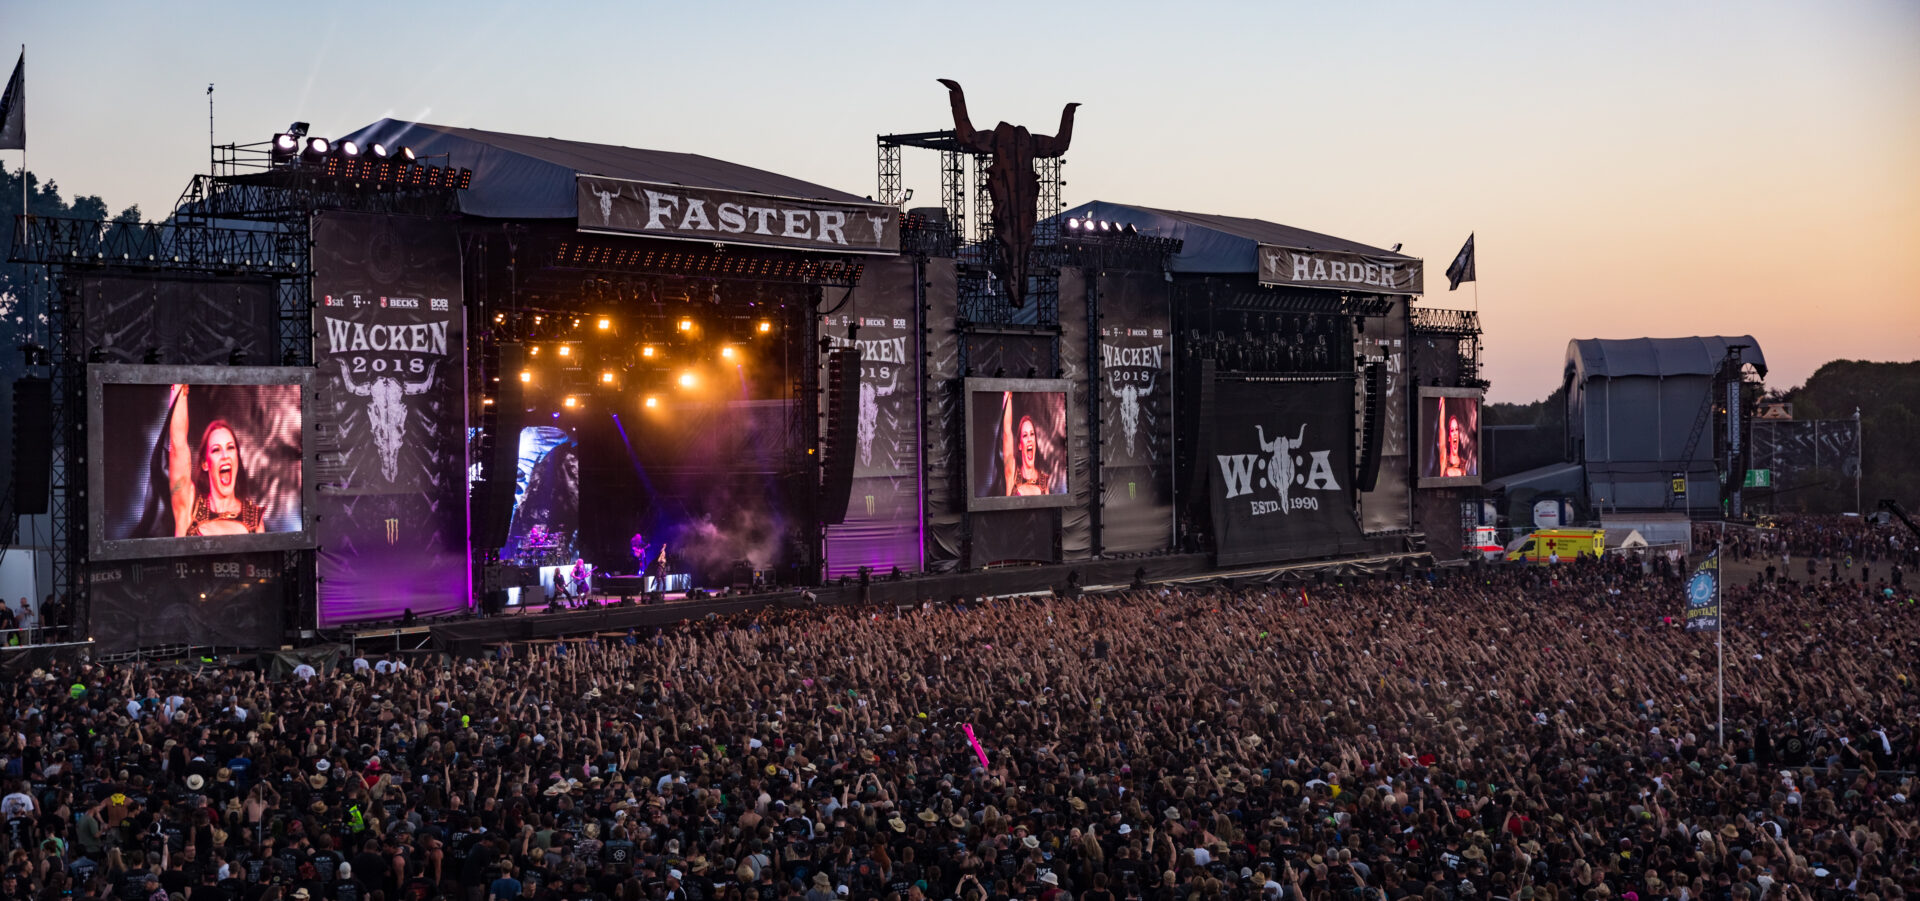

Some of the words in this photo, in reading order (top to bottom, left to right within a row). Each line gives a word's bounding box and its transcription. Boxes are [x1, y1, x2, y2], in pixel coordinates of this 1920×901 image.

[643, 188, 849, 246] FASTER
[1291, 253, 1397, 289] HARDER
[325, 295, 344, 307] 3sat
[390, 299, 419, 307] BECK'S
[325, 316, 449, 356] WACKEN
[1103, 343, 1163, 369] WACKEN
[353, 357, 424, 373] 2018
[1114, 370, 1149, 382] 2018
[1250, 500, 1281, 516] ESTD.
[1290, 497, 1319, 511] 1990
[247, 564, 273, 578] 3sat
